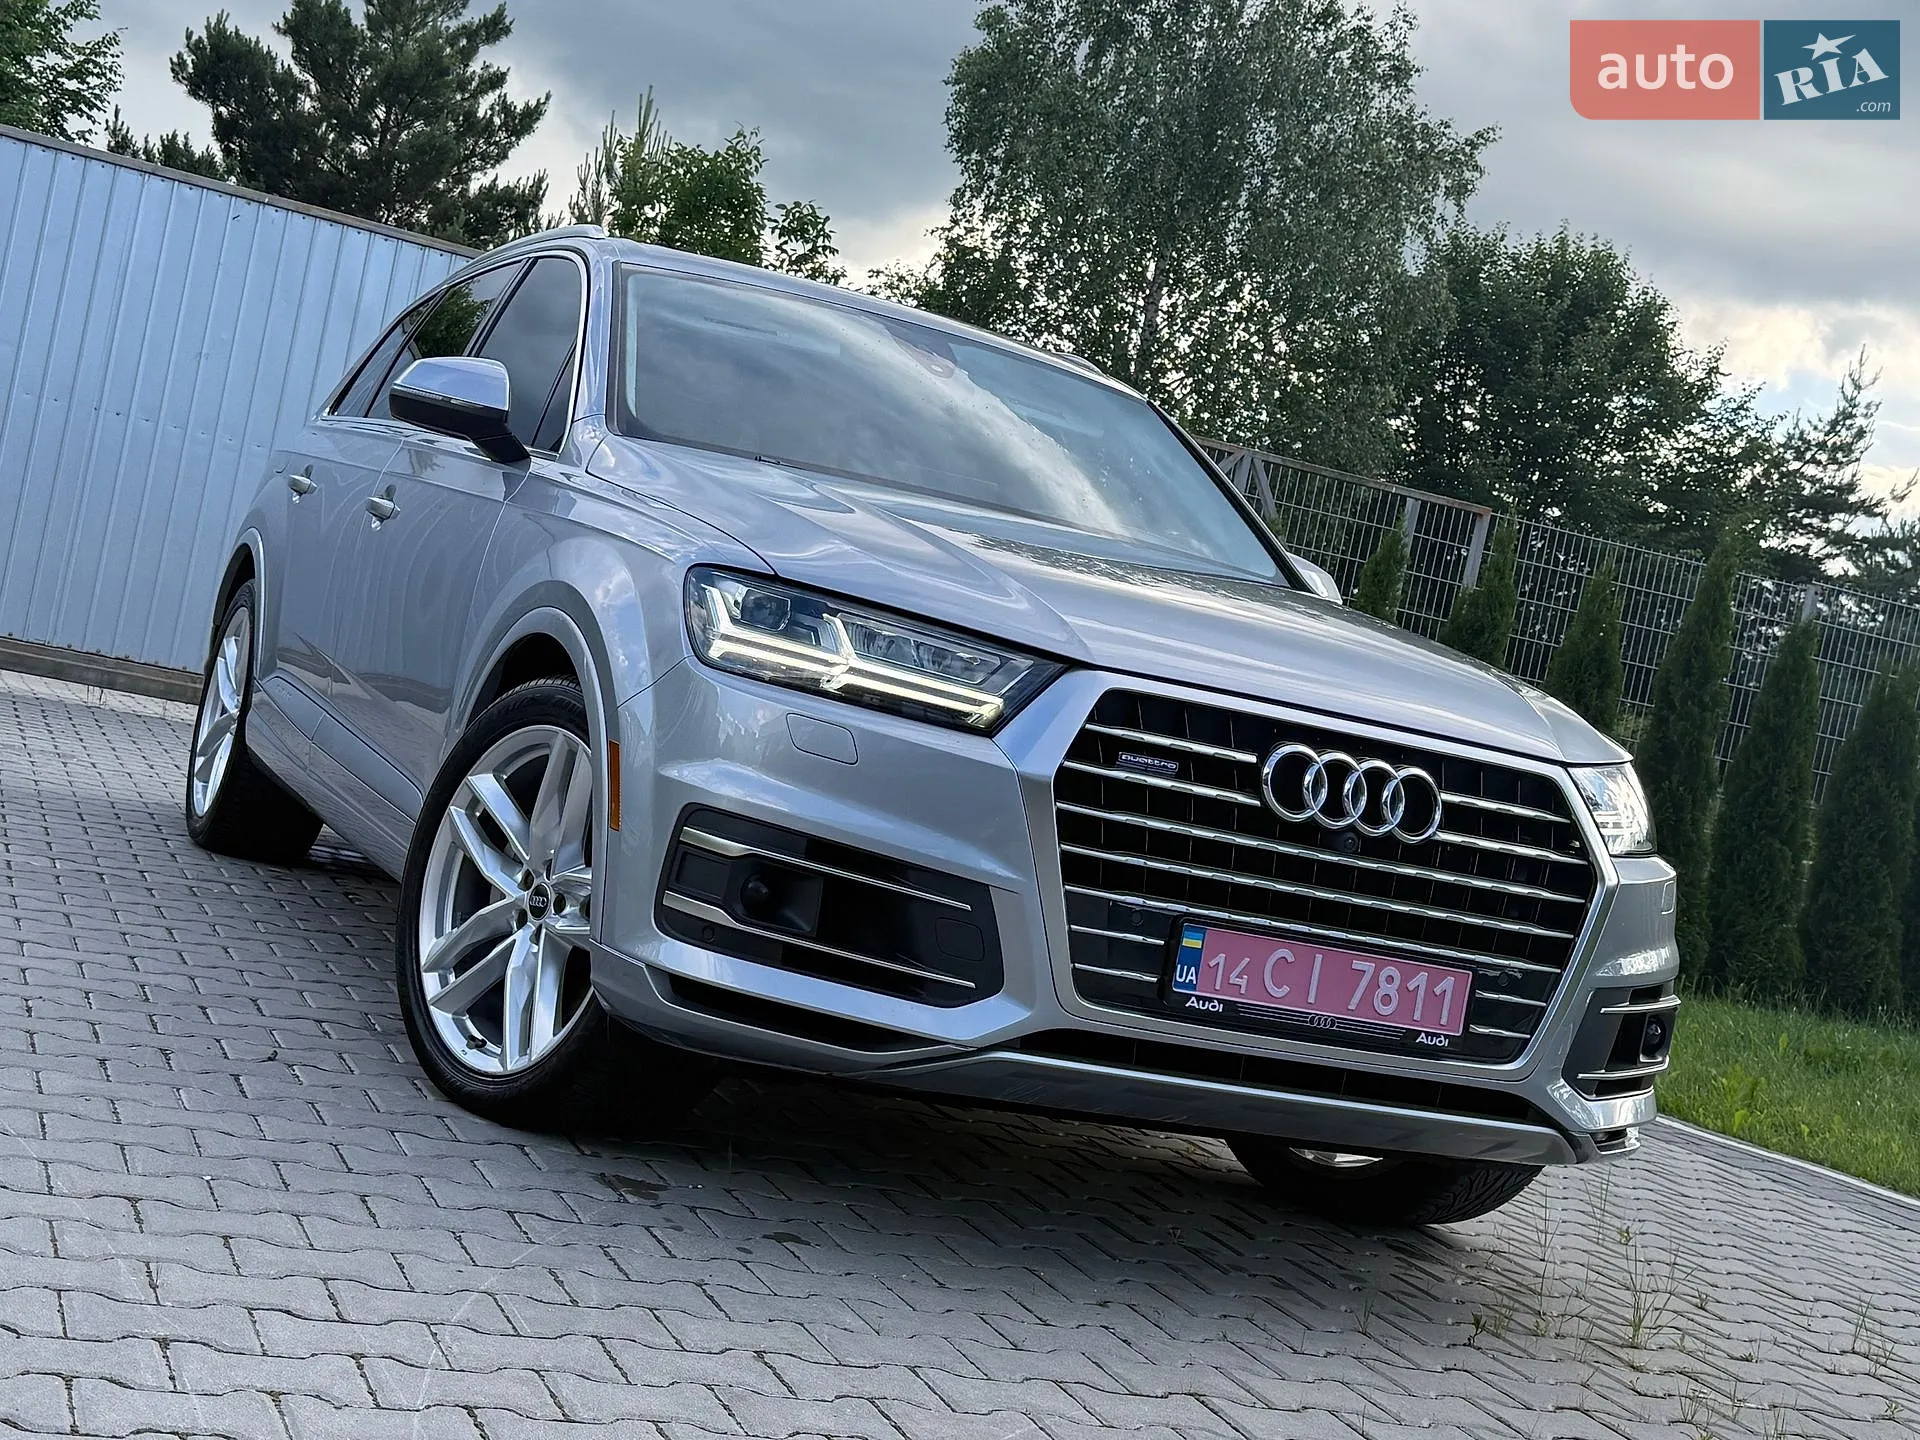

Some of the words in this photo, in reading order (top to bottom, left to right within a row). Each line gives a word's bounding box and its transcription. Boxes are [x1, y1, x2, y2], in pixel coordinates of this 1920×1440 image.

[1176, 964, 1198, 984] UA
[1208, 953, 1250, 994] 14
[1263, 948, 1323, 1004] CI
[1347, 960, 1455, 1026] 7811
[1185, 996, 1224, 1013] Audi
[1415, 1032, 1449, 1047] Audi
